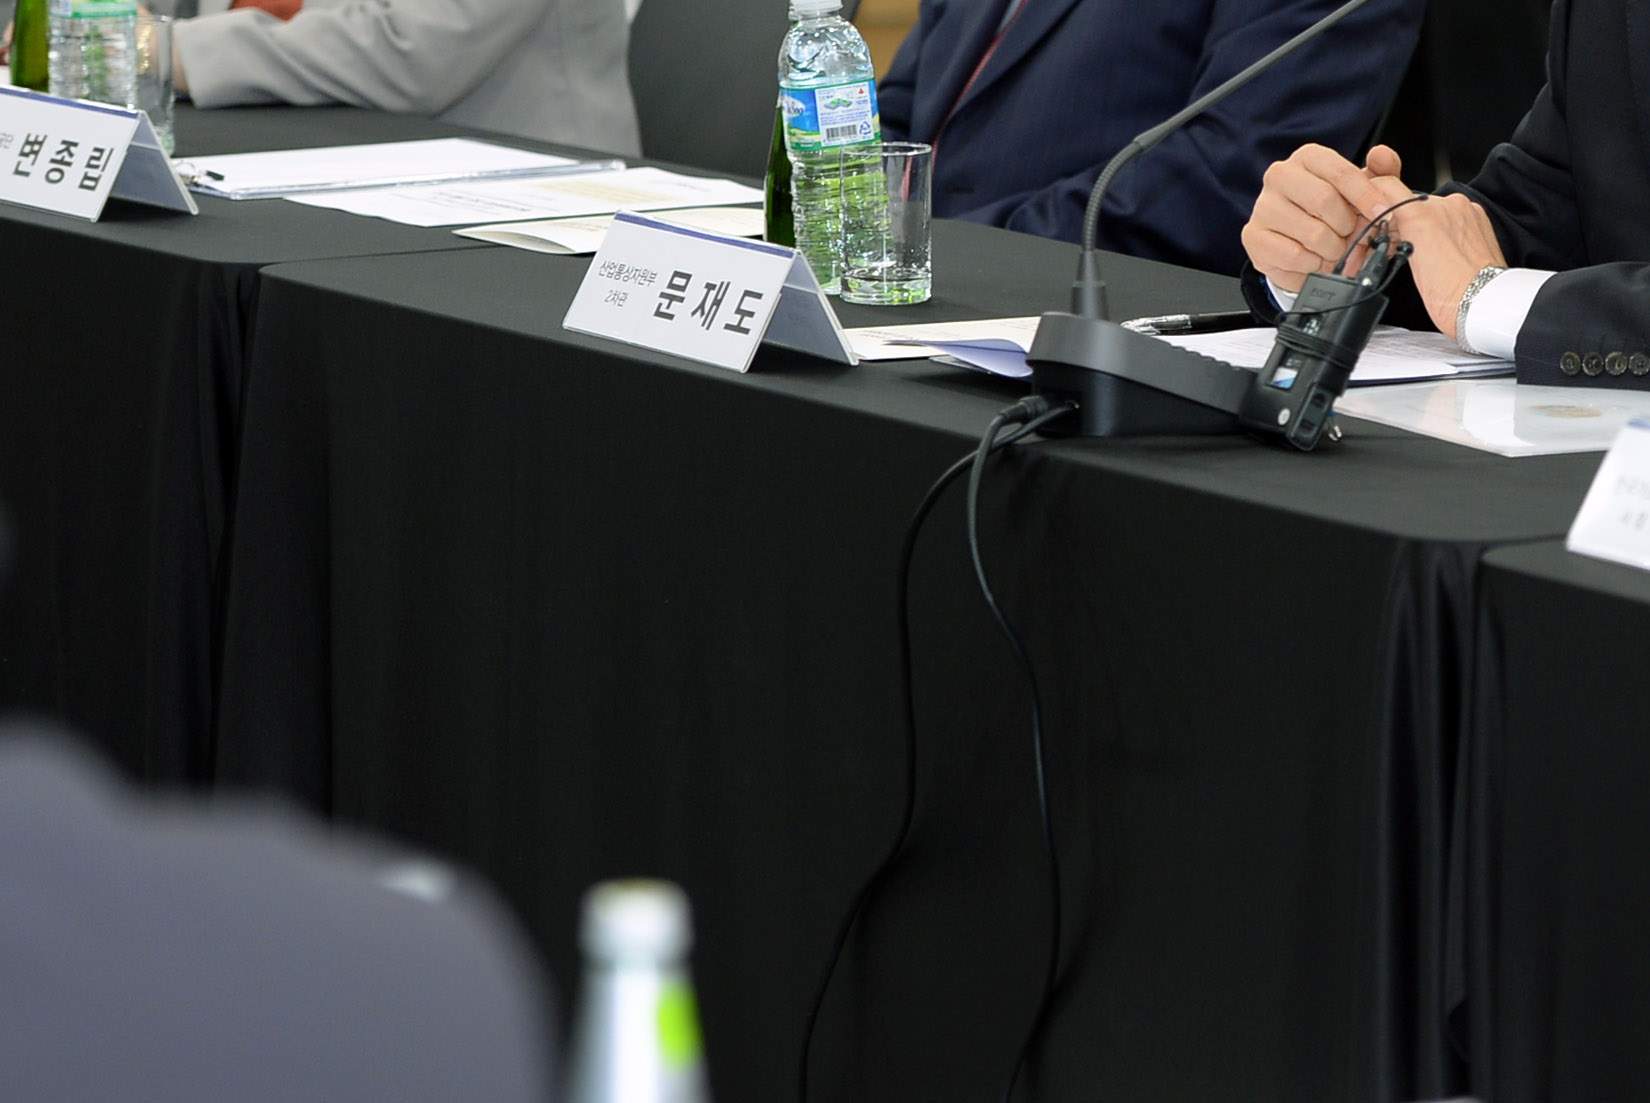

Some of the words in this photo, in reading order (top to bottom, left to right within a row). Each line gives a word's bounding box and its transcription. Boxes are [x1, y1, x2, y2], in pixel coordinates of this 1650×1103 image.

[12, 132, 114, 192] 변종립
[598, 259, 658, 287] 산업통상자원부
[604, 289, 629, 308] 2차관
[653, 270, 764, 335] 문재도
